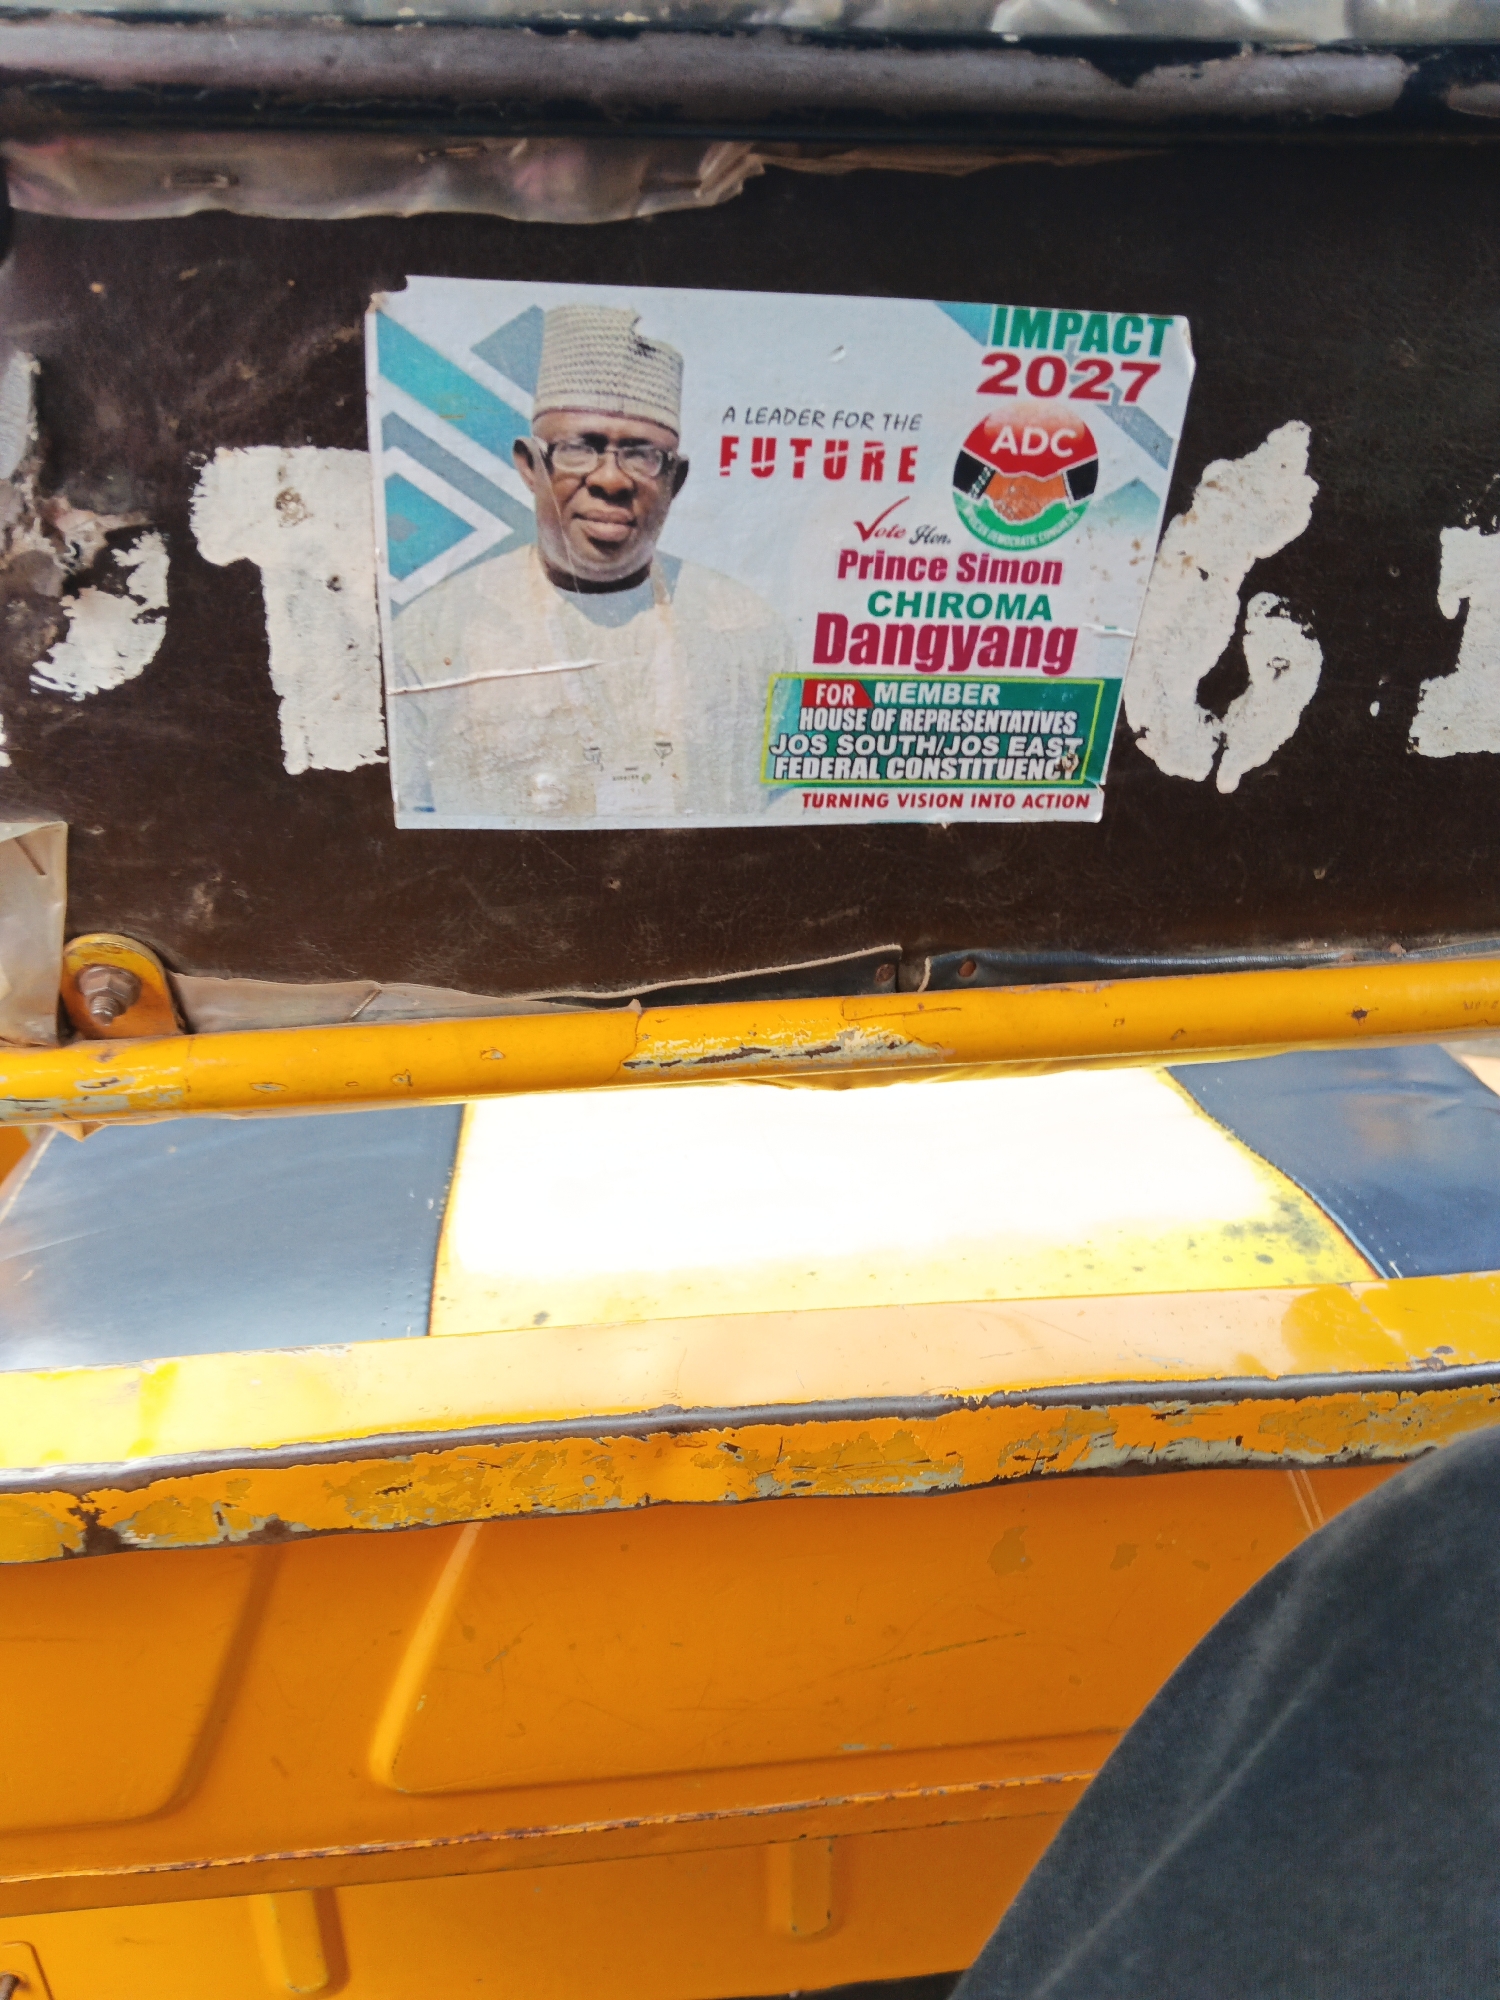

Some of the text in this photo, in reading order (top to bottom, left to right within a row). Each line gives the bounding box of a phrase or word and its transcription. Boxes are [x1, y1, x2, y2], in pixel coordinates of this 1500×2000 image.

[991, 307, 1174, 358] IMPACT
[976, 352, 1162, 404] 2027
[722, 406, 923, 432] A LEADER FOR THE
[990, 426, 1077, 458] ADC
[719, 435, 919, 483] FUTURE
[853, 495, 910, 543] Vote
[837, 549, 1063, 586] Prince Simon
[867, 590, 1052, 622] CHIROMA
[812, 612, 1079, 676] Dangyang
[815, 682, 1001, 706] FOR MEMBER
[799, 707, 1077, 735] HOUSE OF REPRESENTATIVES
[769, 733, 1084, 758] JOS SOUTH/JOS EAST
[774, 756, 881, 780] FEDERAL
[802, 792, 1091, 810] TURNING VISION INTO ACTION
